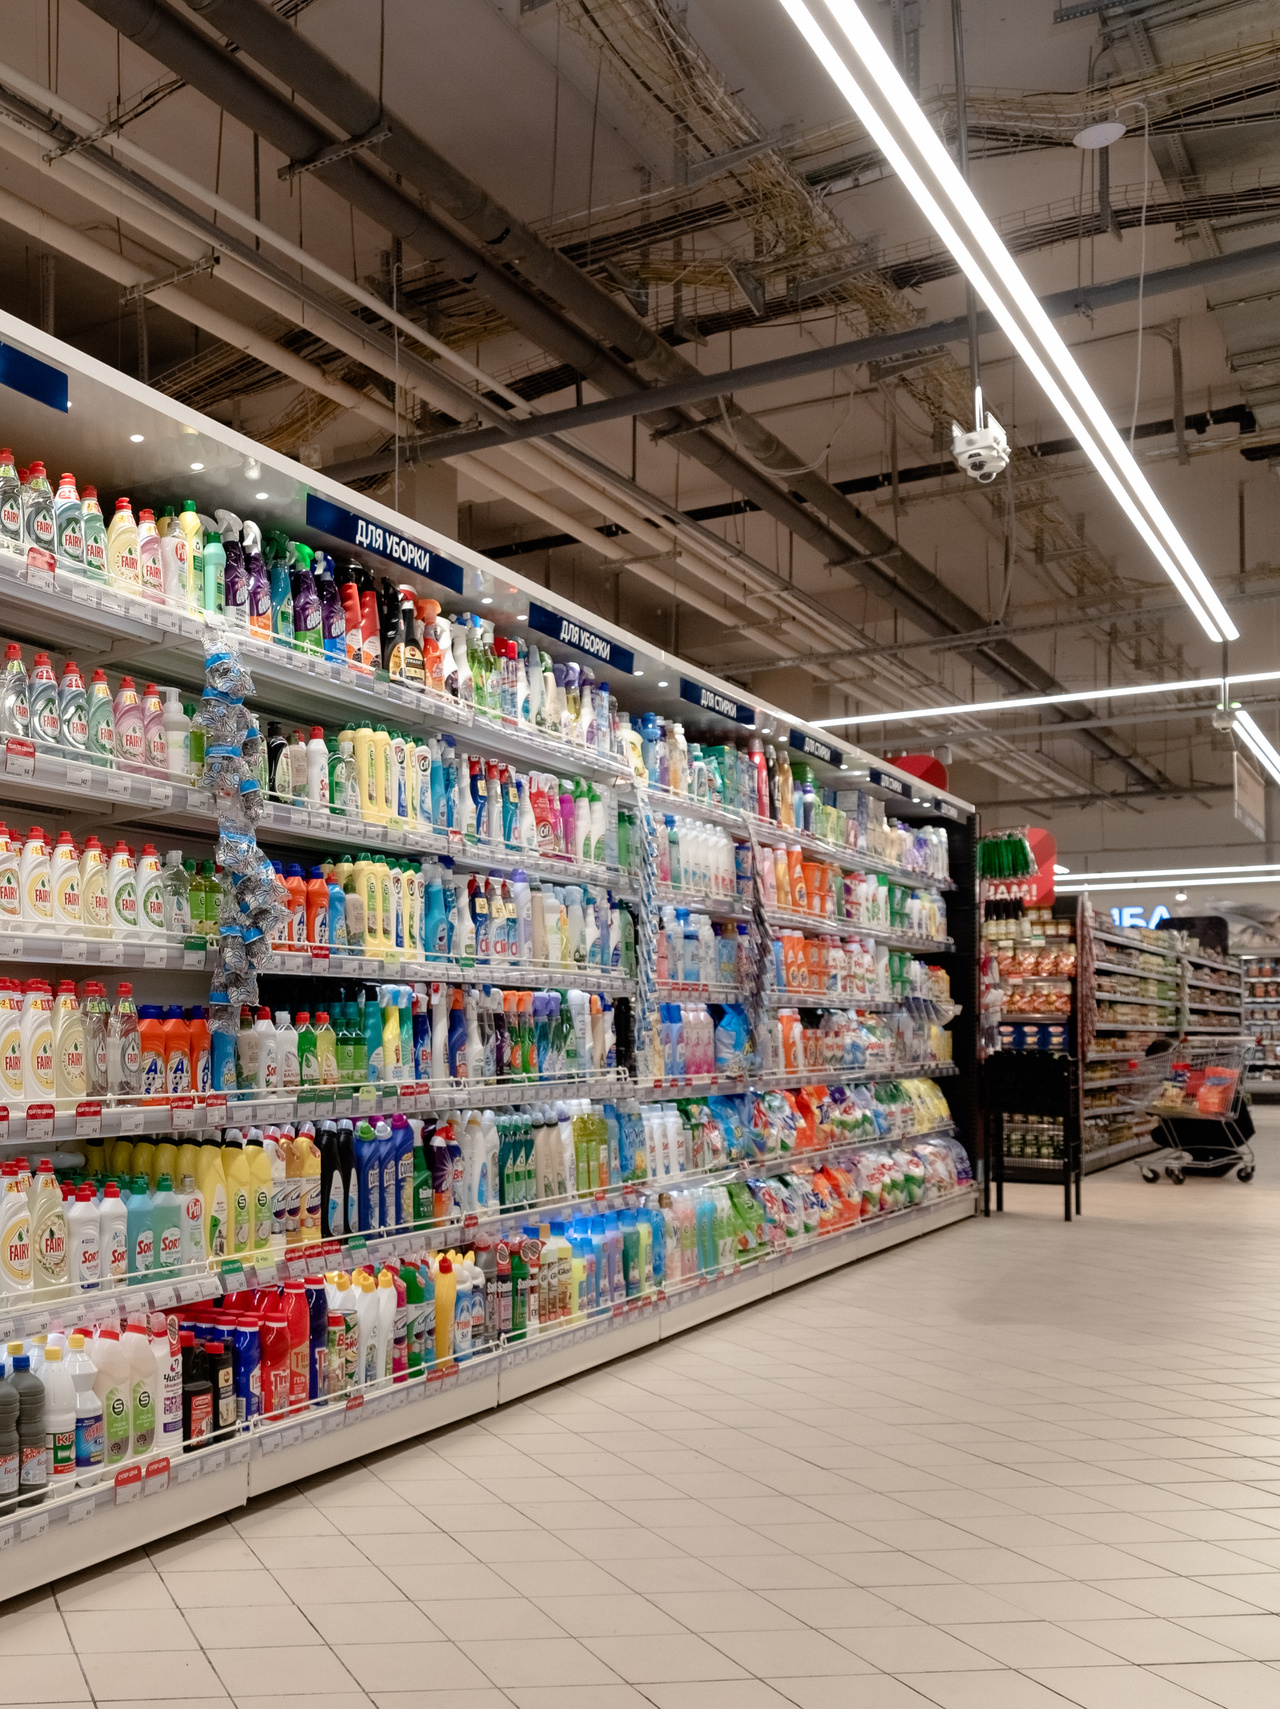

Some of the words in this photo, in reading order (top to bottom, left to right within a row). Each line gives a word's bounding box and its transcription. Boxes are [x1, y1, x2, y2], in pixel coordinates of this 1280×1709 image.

[3, 509, 20, 525] FAIRY
[36, 519, 53, 535] FAIRY
[64, 534, 82, 549] FAIRY
[355, 519, 384, 551] ДЛЯ
[385, 532, 430, 574] УБОРКИ
[121, 554, 138, 571] FAIRY
[560, 620, 579, 641] ДЛЯ
[580, 629, 611, 661] УБОРКИ
[700, 688, 715, 708] ДЛЯ
[125, 733, 143, 748] FAIRY
[0, 885, 18, 901] FAIRY
[9, 1242, 30, 1263] FAIRY
[44, 1235, 65, 1256] FAIRY
